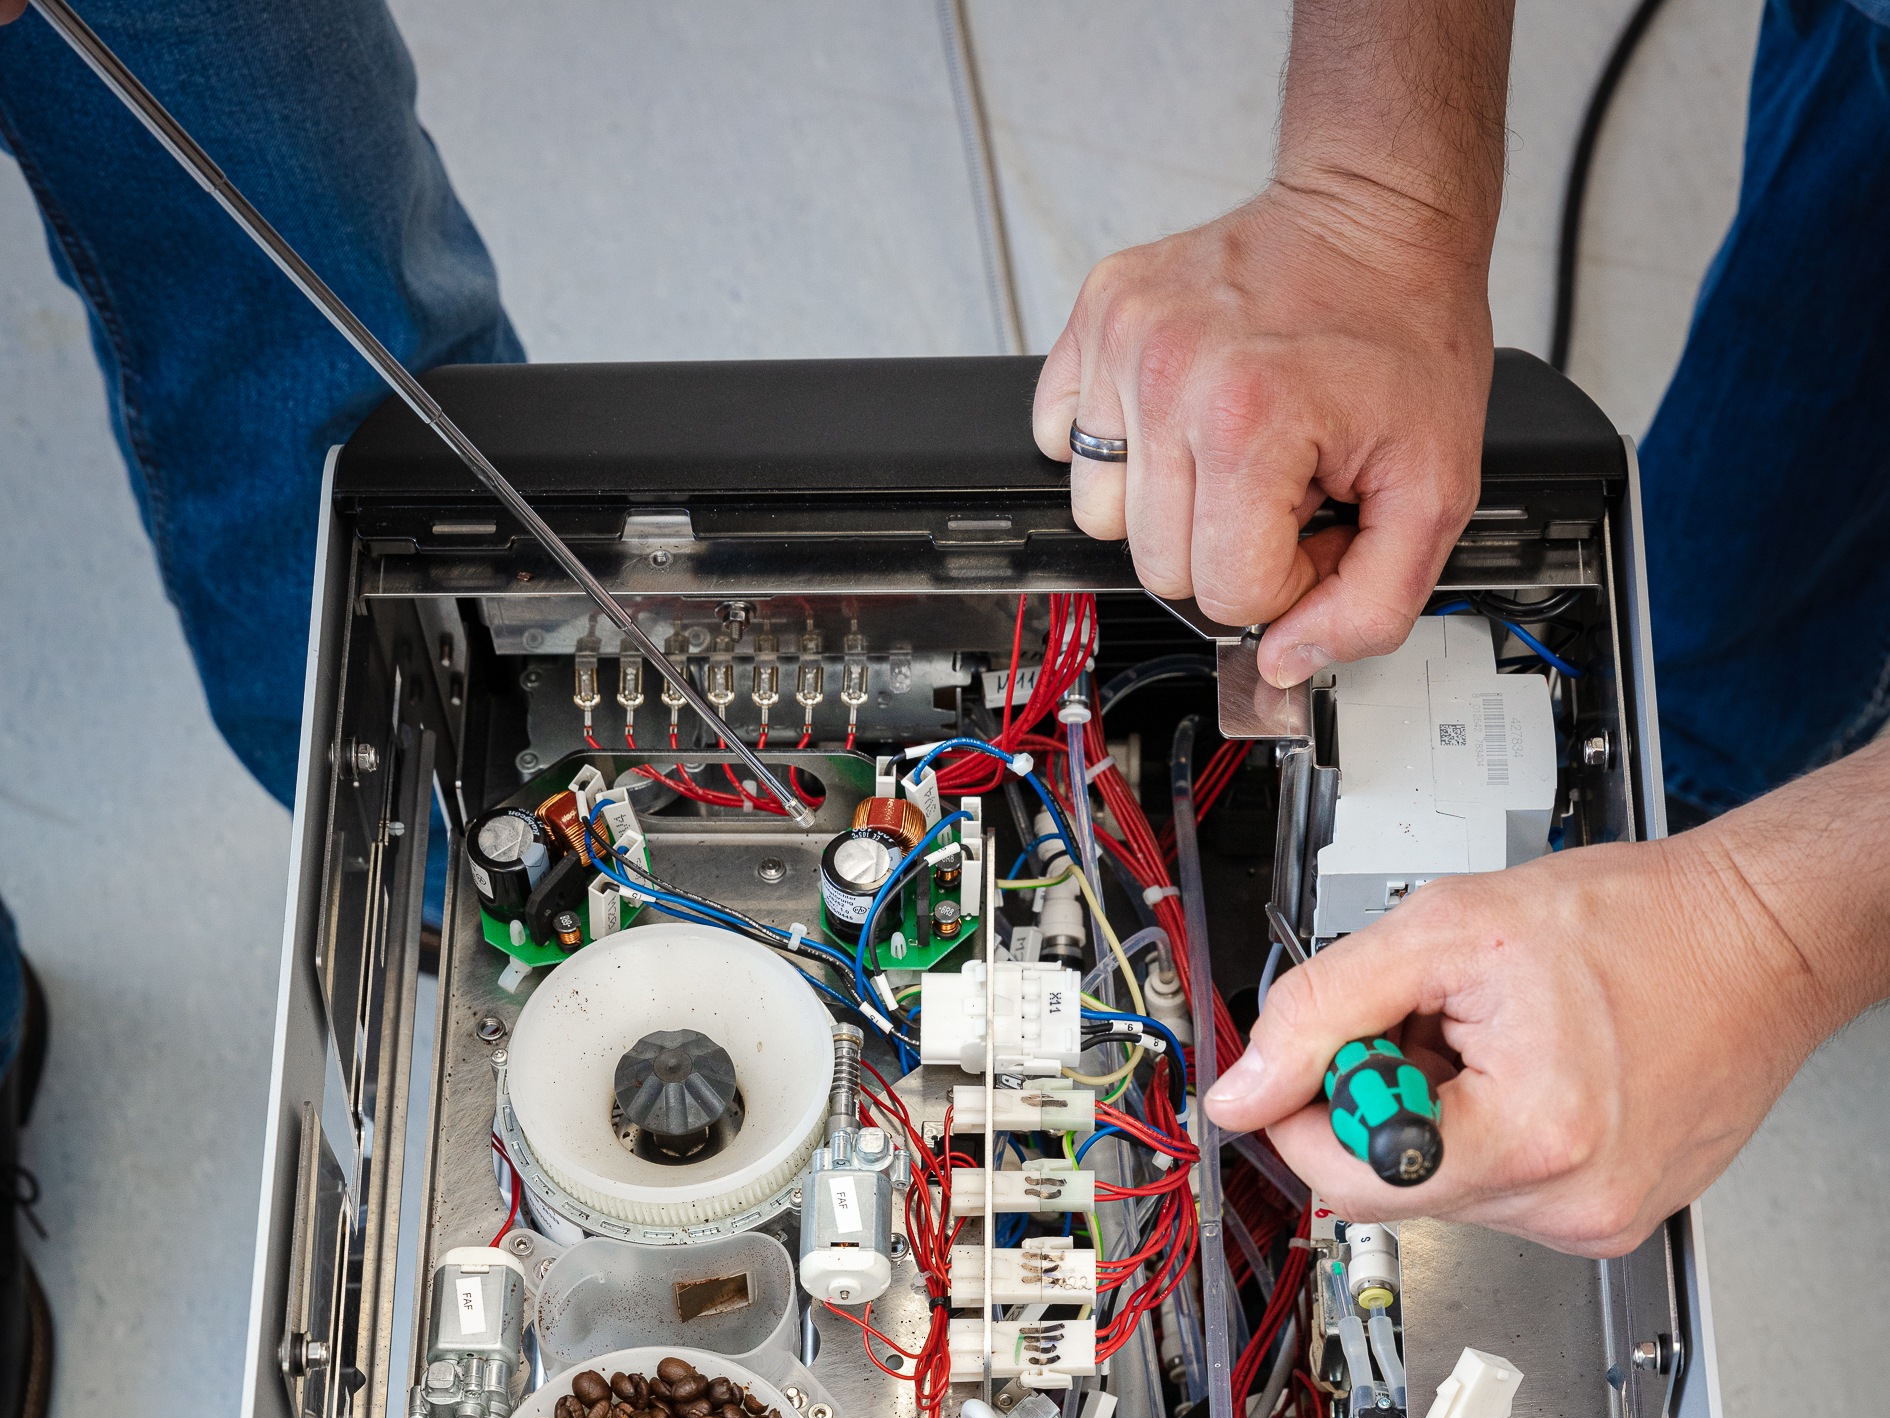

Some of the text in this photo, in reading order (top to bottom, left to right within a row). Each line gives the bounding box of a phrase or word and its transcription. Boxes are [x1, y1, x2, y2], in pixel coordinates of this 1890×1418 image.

[1510, 717, 1524, 759] 427834
[1049, 992, 1062, 1014] X11
[836, 1191, 848, 1209] FAF
[462, 1292, 473, 1310] FAF
